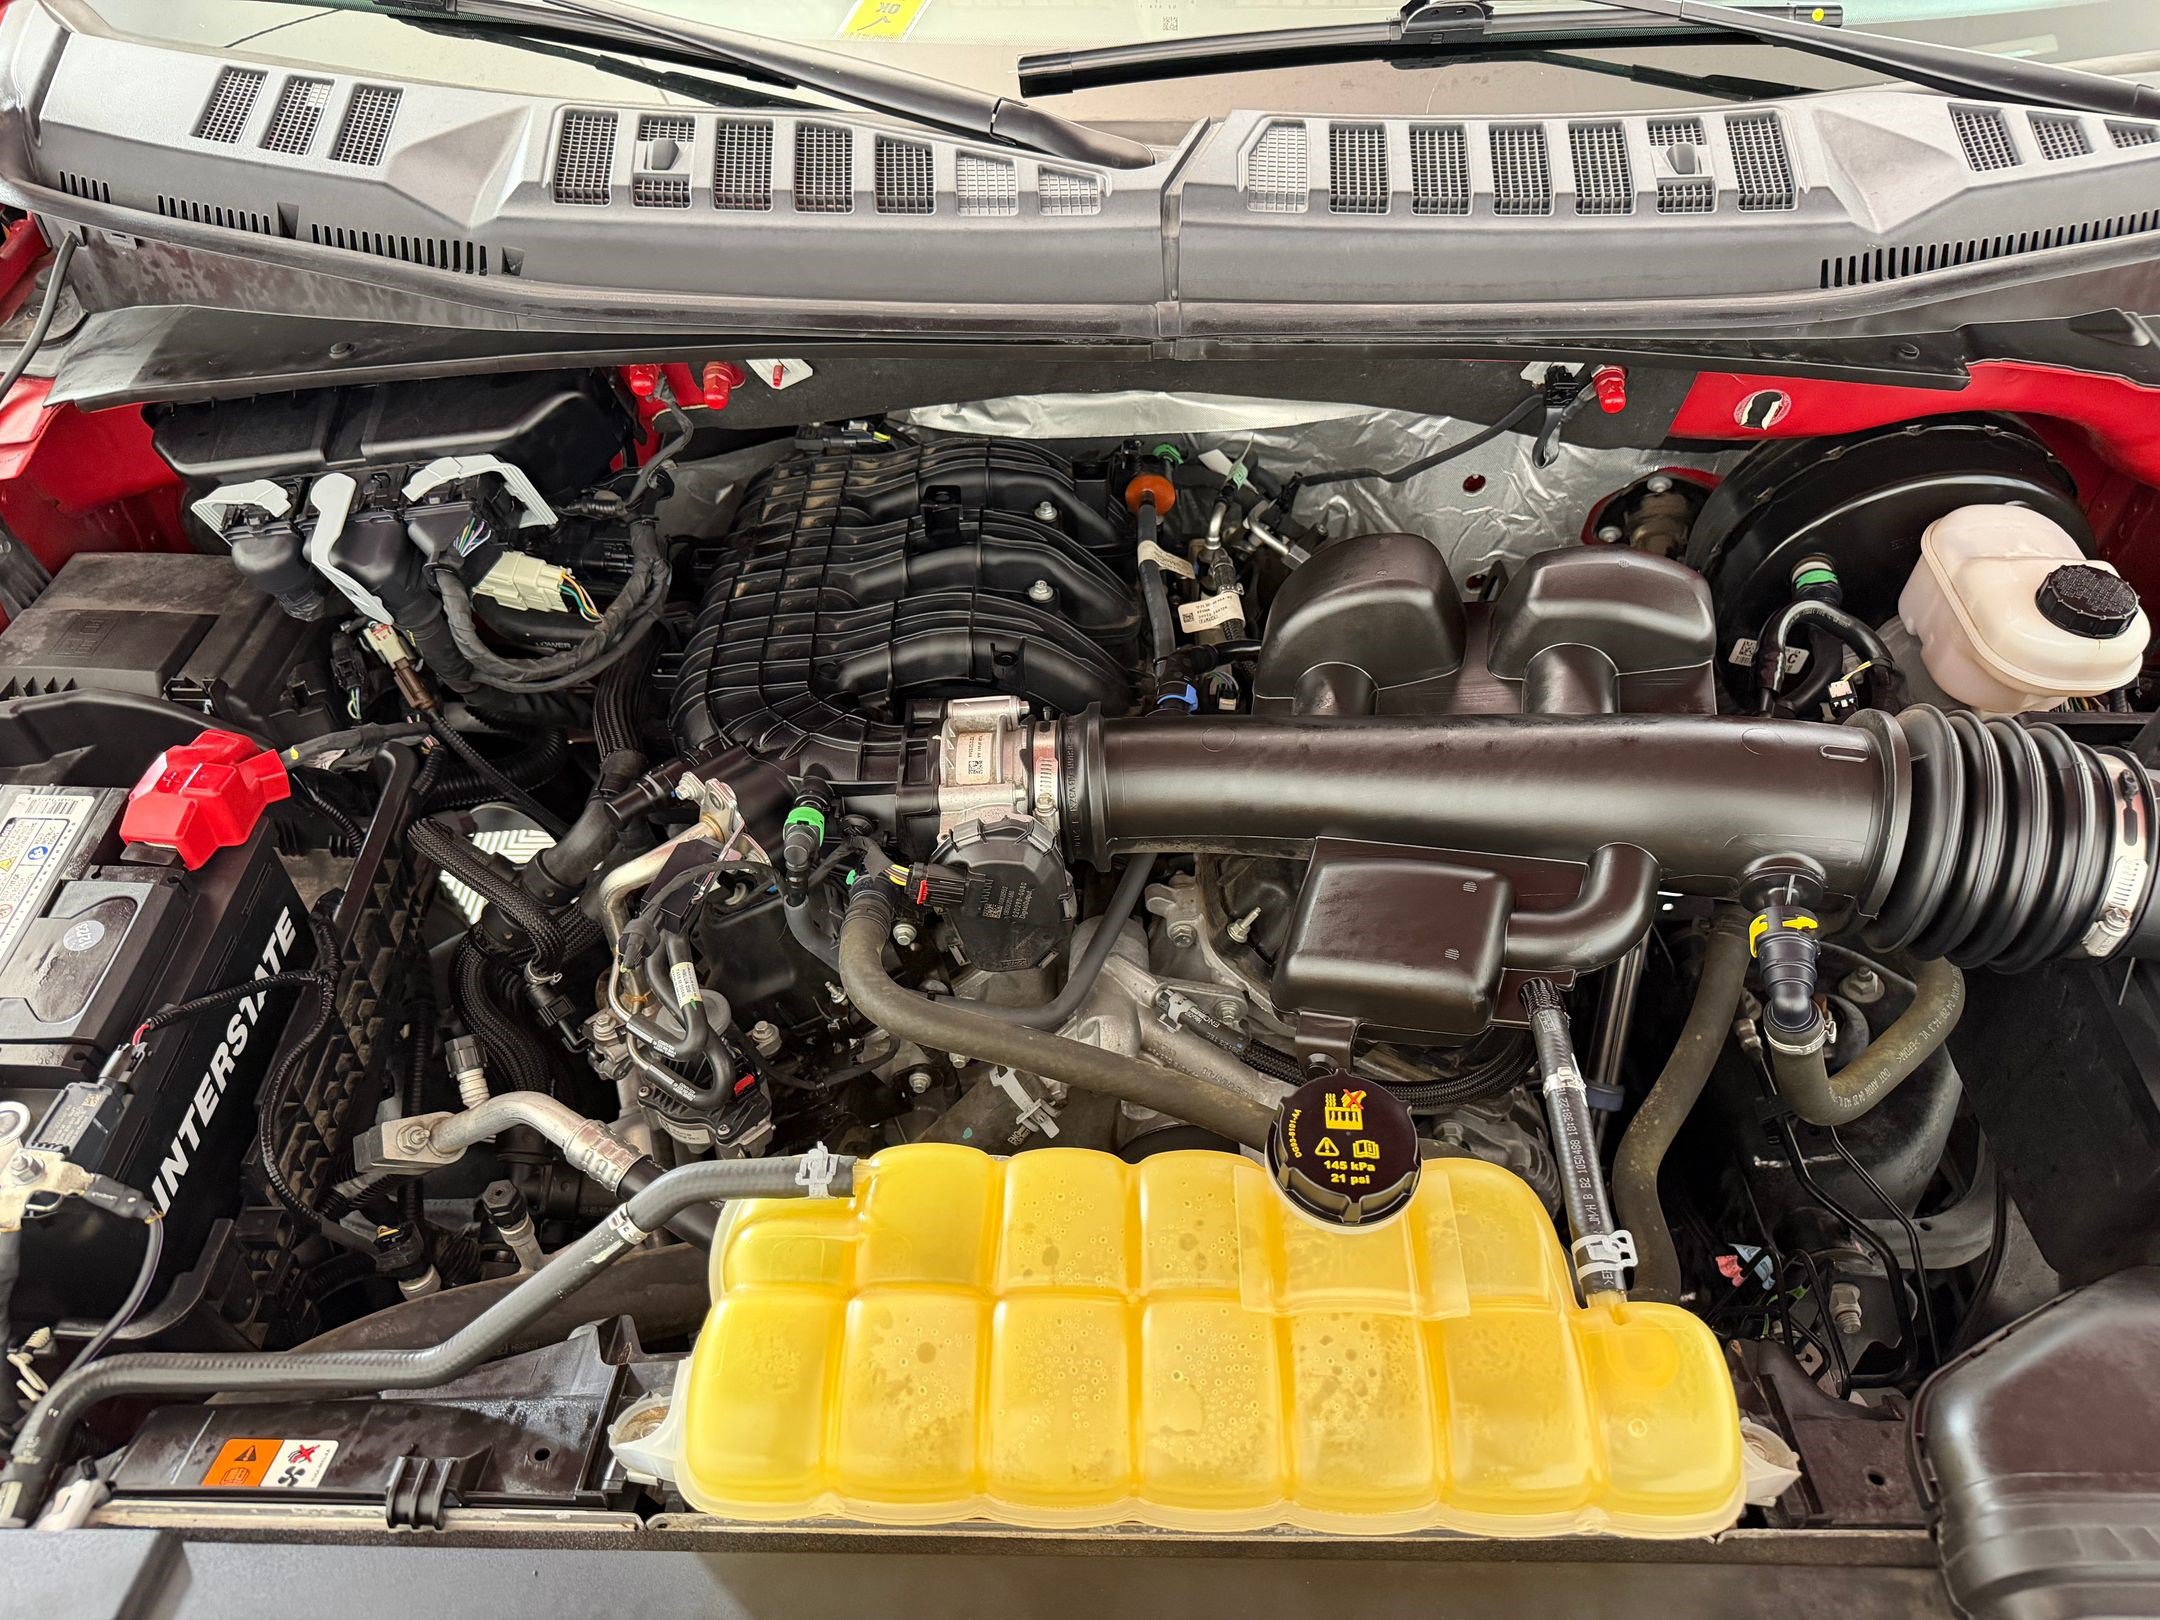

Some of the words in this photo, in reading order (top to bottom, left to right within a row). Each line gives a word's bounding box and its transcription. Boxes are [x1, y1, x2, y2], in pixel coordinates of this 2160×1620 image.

[74, 923, 94, 949] 12/23
[152, 906, 296, 1215] INTERSTATE
[1560, 1097, 1578, 1136] 18:38:22
[1324, 1160, 1348, 1170] 145
[1350, 1161, 1376, 1171] kPa
[1569, 1139, 1587, 1174] 1050488
[1331, 1173, 1346, 1183] 21
[1350, 1175, 1370, 1185] psi
